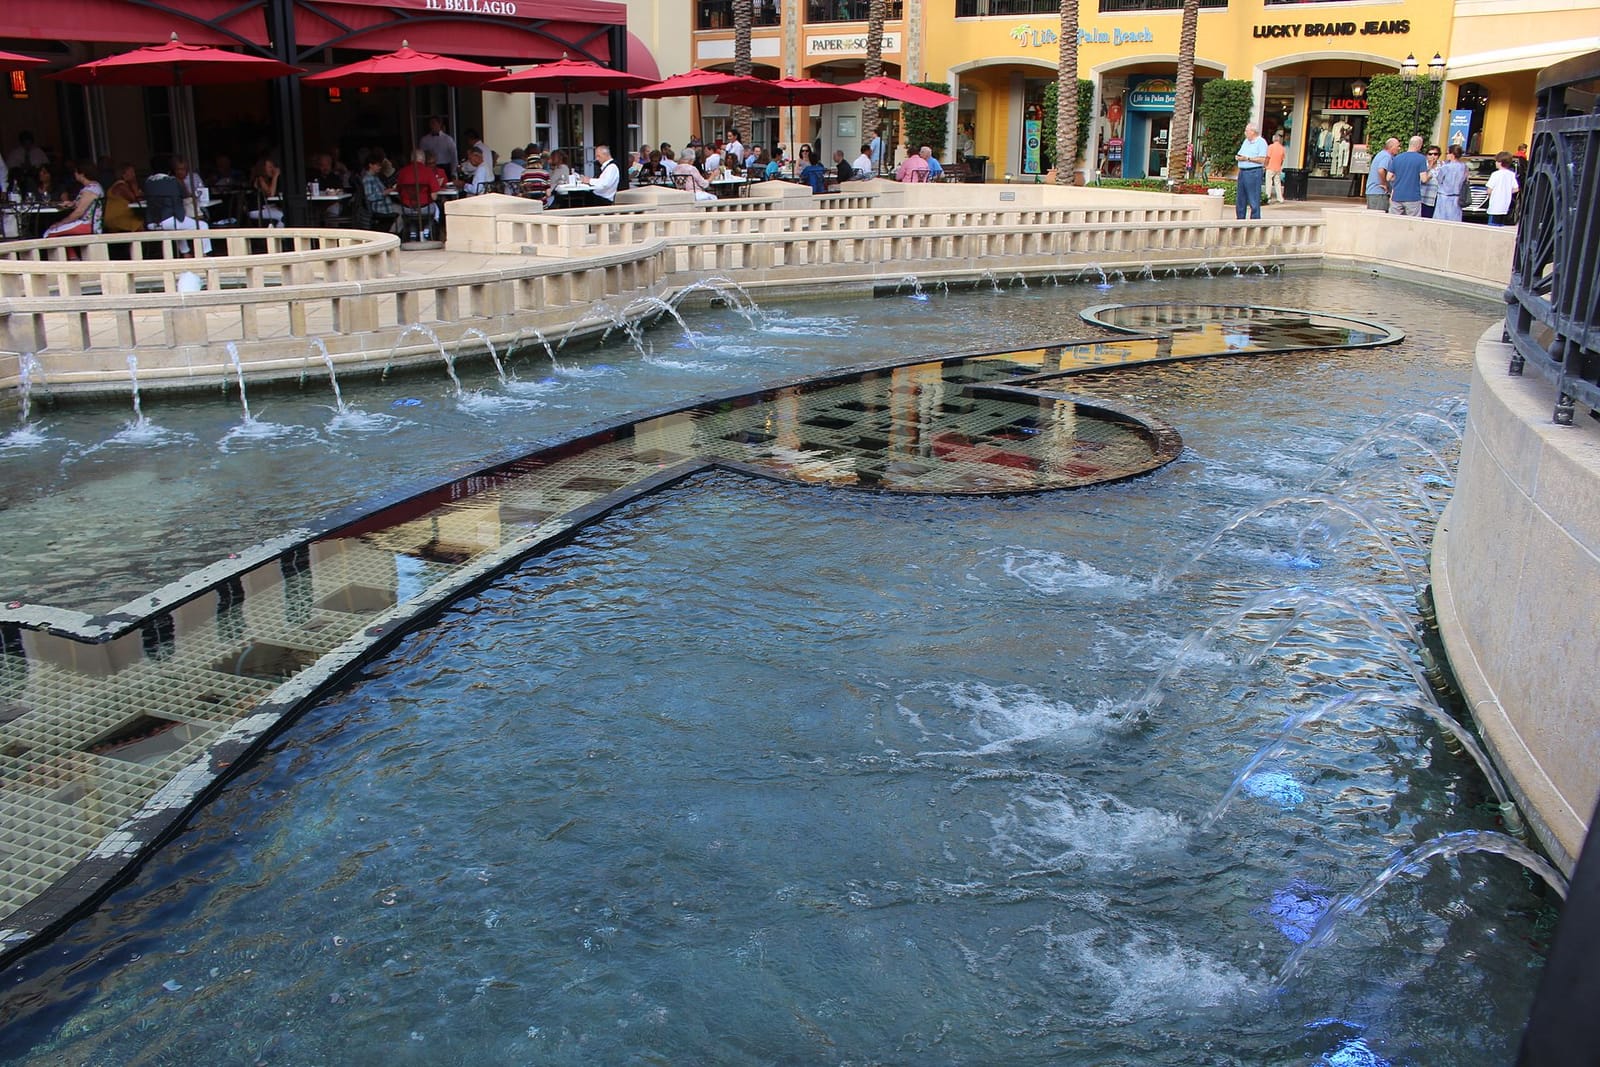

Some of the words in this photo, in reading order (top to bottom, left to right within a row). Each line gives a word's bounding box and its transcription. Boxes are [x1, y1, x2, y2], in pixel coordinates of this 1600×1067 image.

[426, 0, 441, 9] IL
[445, 0, 516, 15] BELLAGIO
[1032, 28, 1057, 47] Life
[1077, 27, 1110, 45] Palm
[1113, 26, 1153, 46] Beach
[1253, 24, 1301, 38] LUCKY
[1304, 22, 1357, 37] BRAND
[1360, 20, 1411, 35] JEANS
[812, 39, 843, 50] PAPER
[854, 37, 894, 49] SOCE
[1330, 98, 1368, 109] LUCKY
